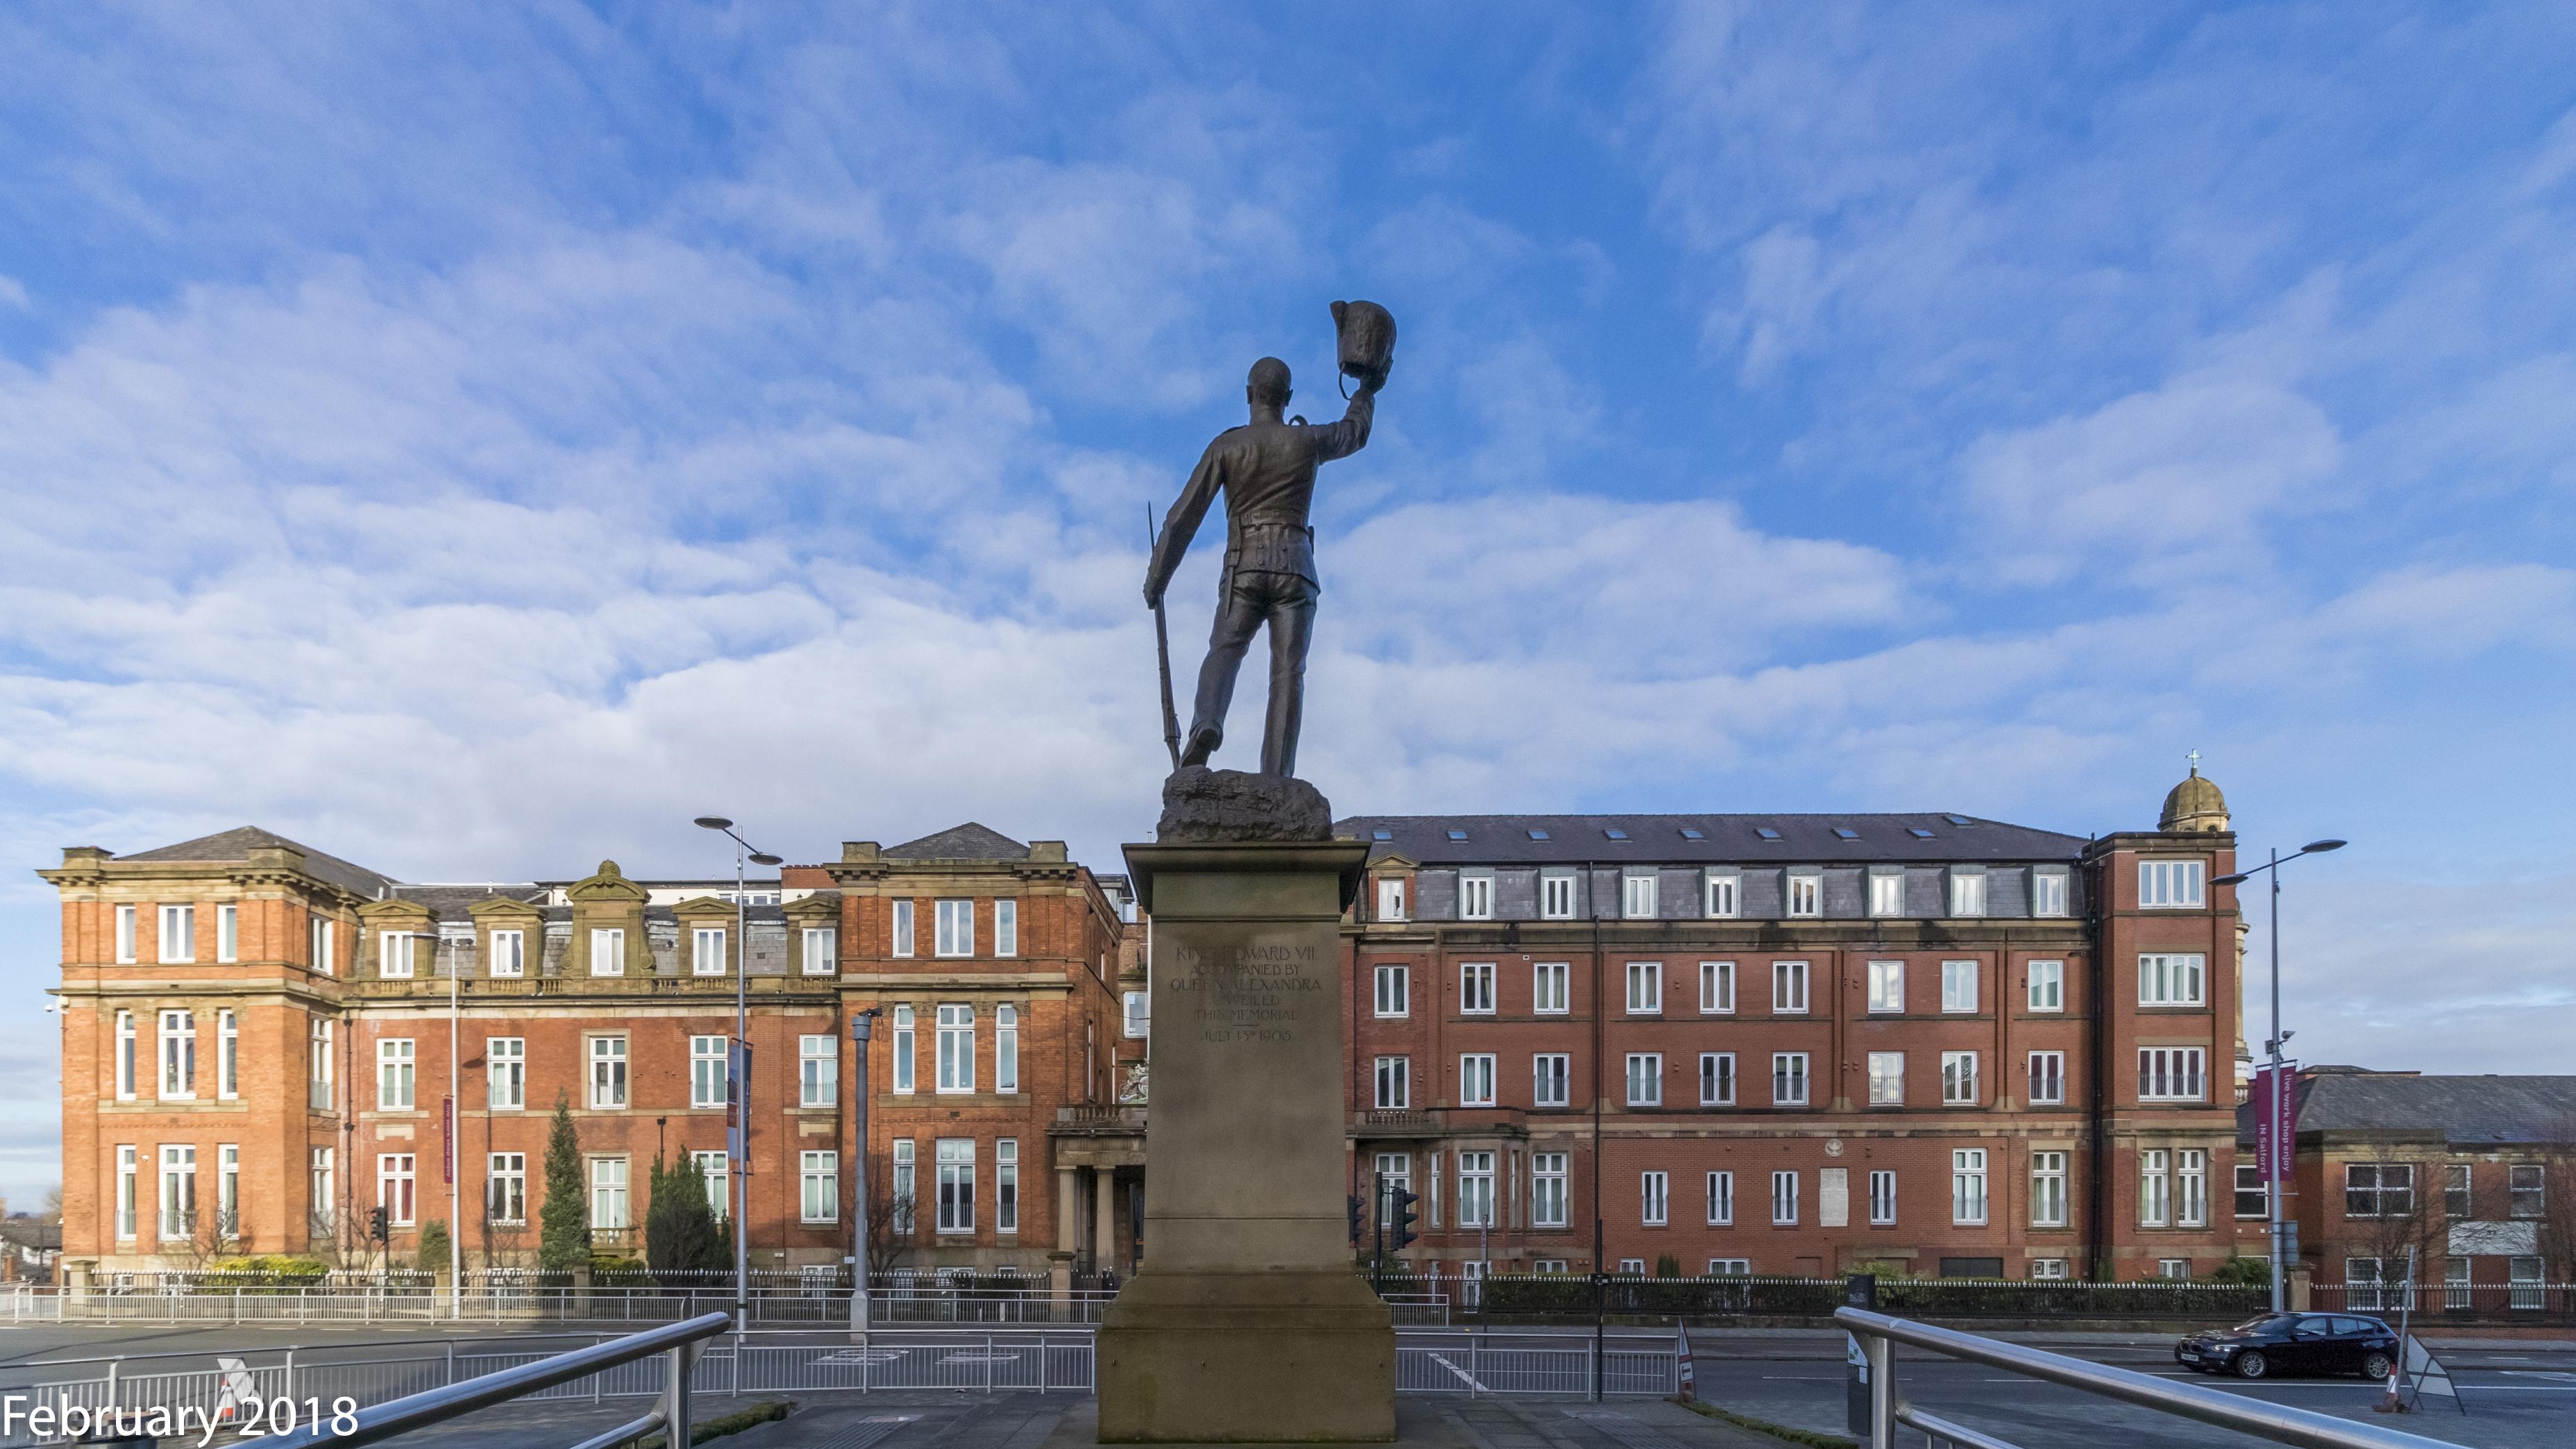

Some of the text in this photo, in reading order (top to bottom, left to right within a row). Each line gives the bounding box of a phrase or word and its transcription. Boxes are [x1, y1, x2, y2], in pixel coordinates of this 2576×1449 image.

[1190, 964, 1302, 975] ACCOMPANIED BY
[1170, 978, 1322, 991] QUEEN ALEXANDRA
[1213, 994, 1280, 1006] UNVEILED
[1195, 1009, 1297, 1021] THIS MEMORIAL
[1204, 1030, 1231, 1041] JULY
[1260, 1030, 1292, 1043] 1905
[2284, 1074, 2292, 1091] live
[2259, 1124, 2266, 1134] IN
[2282, 1146, 2291, 1171] enjoy
